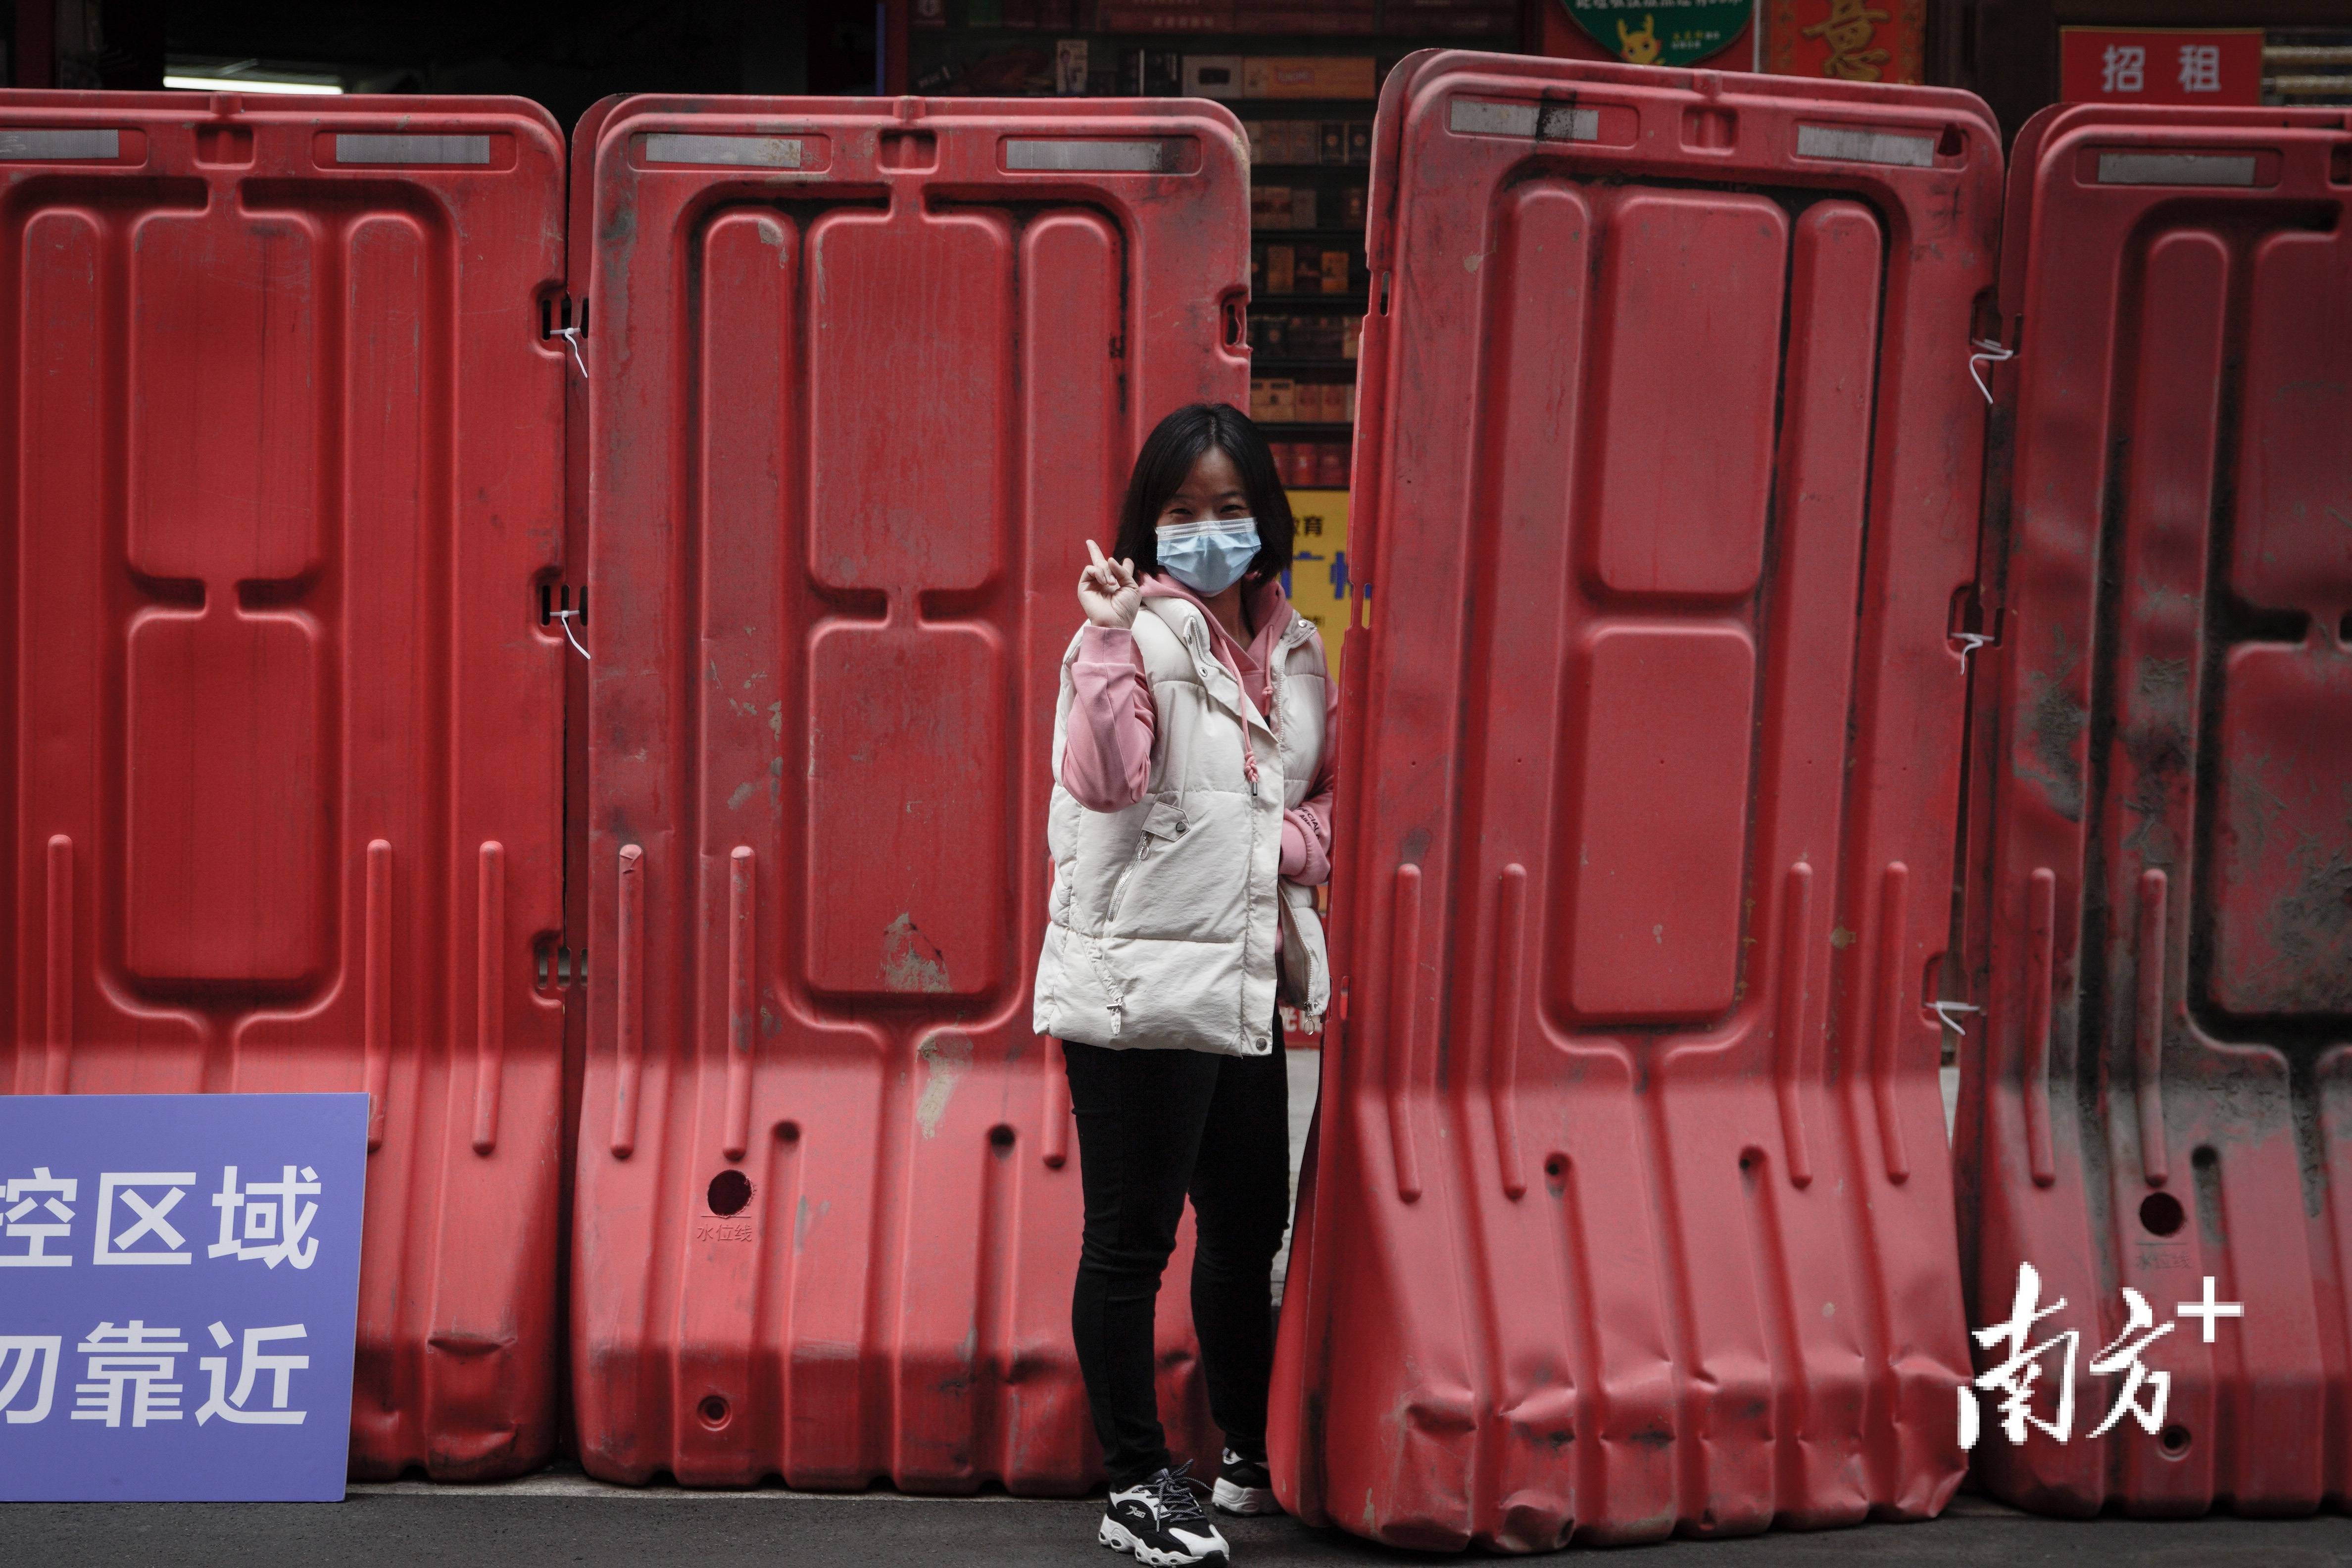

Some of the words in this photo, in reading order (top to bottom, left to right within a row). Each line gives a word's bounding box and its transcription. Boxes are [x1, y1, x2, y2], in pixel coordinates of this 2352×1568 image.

[2101, 44, 2222, 94] 招租
[0, 1165, 322, 1270] 控区域
[697, 1223, 752, 1242] 水位线
